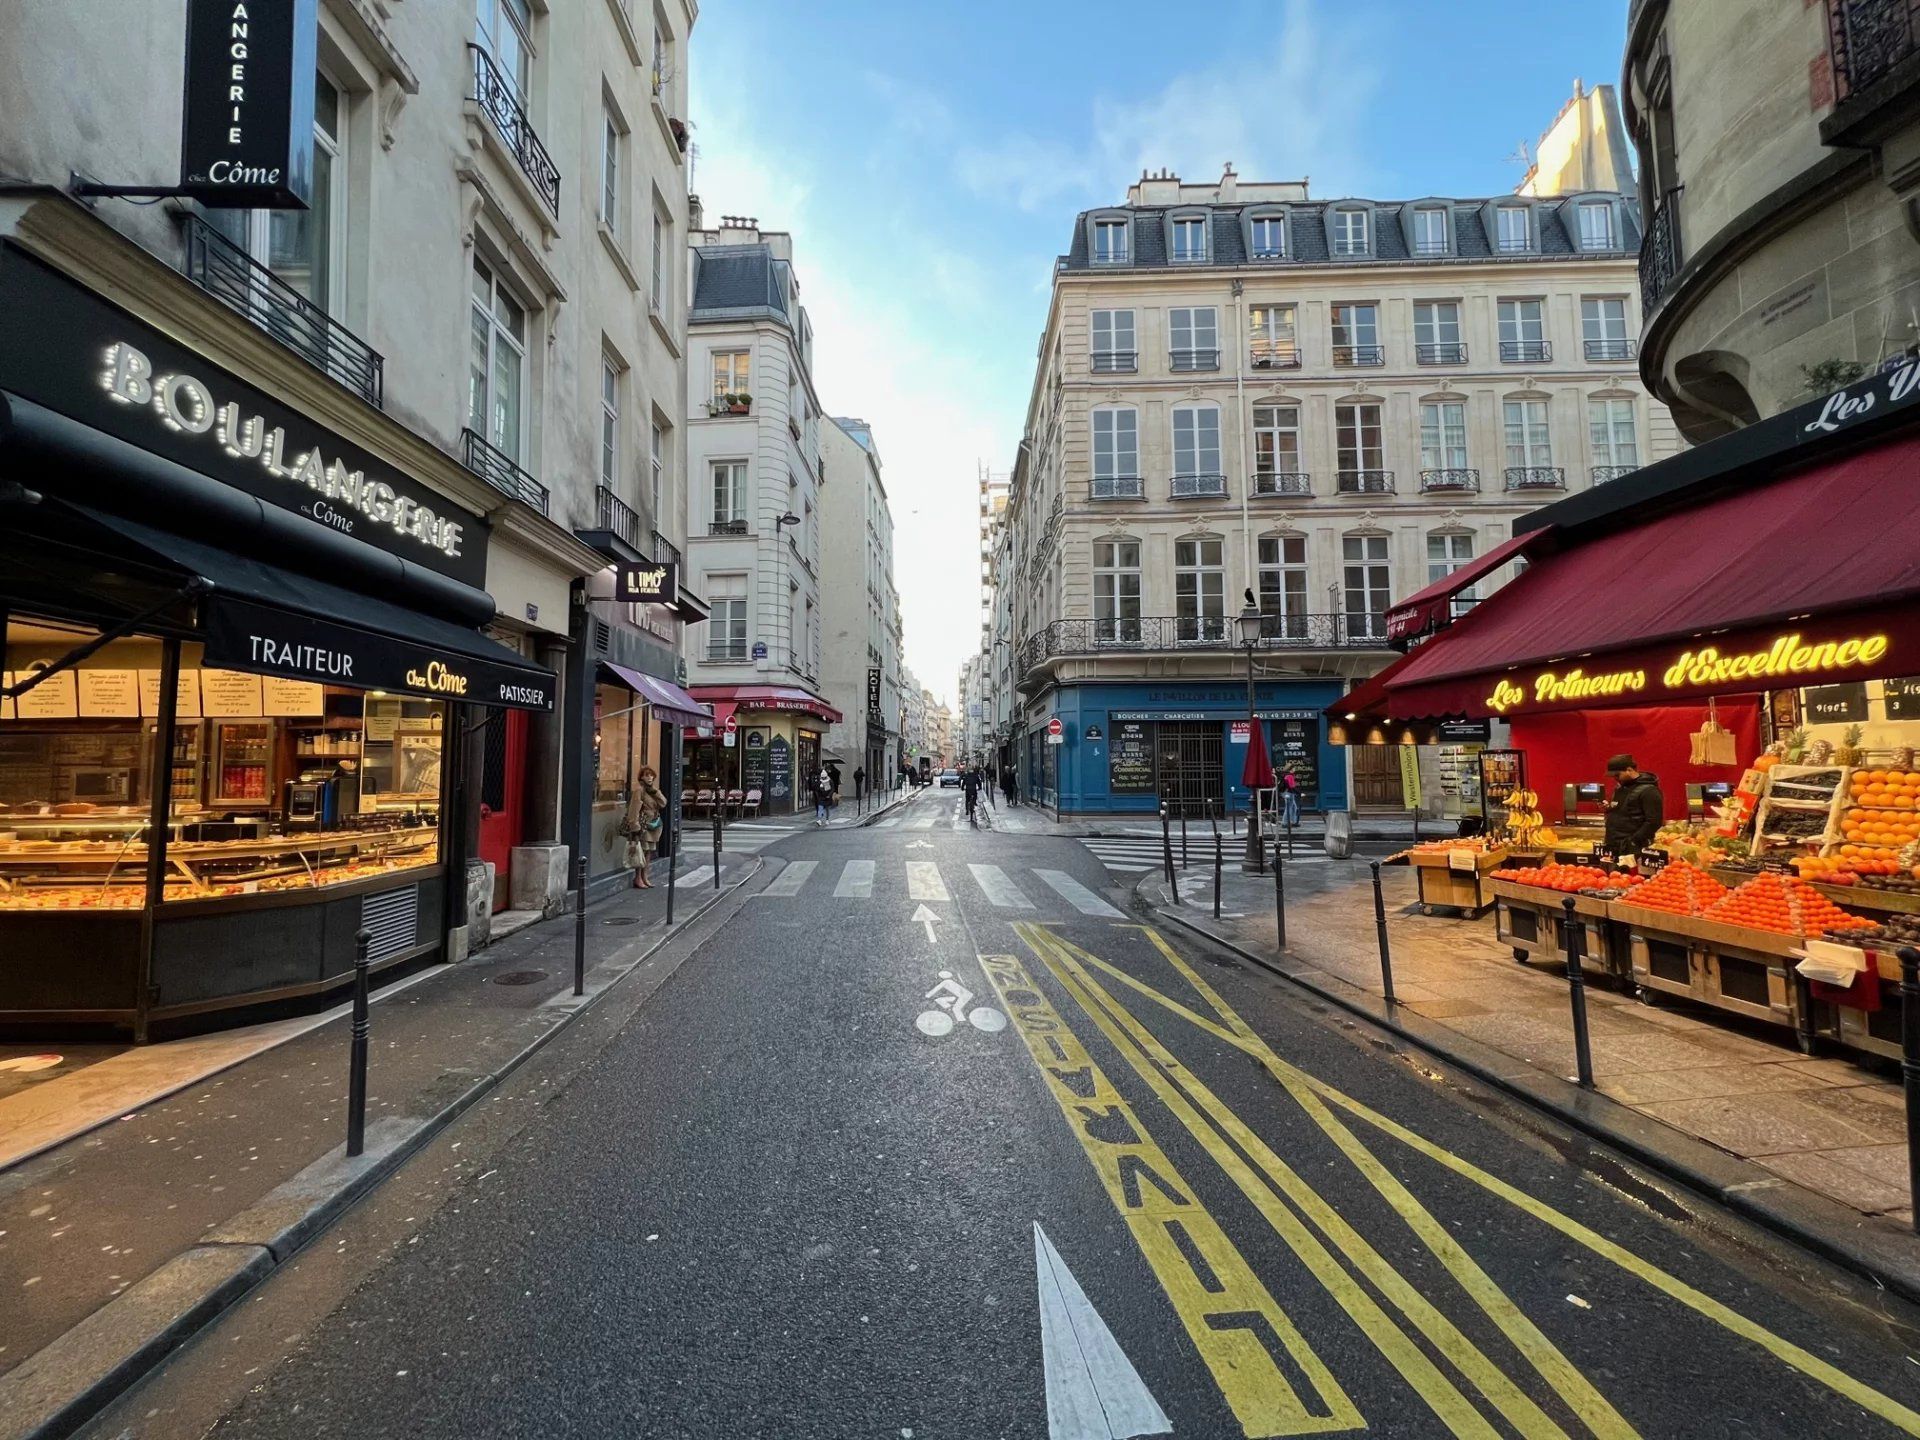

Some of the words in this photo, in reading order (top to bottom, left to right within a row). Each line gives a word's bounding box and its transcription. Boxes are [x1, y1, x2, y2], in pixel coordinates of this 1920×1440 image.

[209, 160, 280, 184] Côme
[1804, 391, 1876, 432] Les
[99, 341, 464, 557] BOULANGERIE
[313, 501, 354, 533] Côme
[1391, 607, 1418, 624] domicile
[250, 635, 353, 677] TRAITEUR
[1486, 680, 1523, 711] Les
[1534, 669, 1645, 701] Primeurs
[1663, 634, 1889, 687] d'Excellence
[406, 669, 427, 688] Chez
[427, 660, 468, 695] Côme
[500, 684, 544, 706] PATISSIER
[983, 956, 1334, 1418] LIVRAISONS
